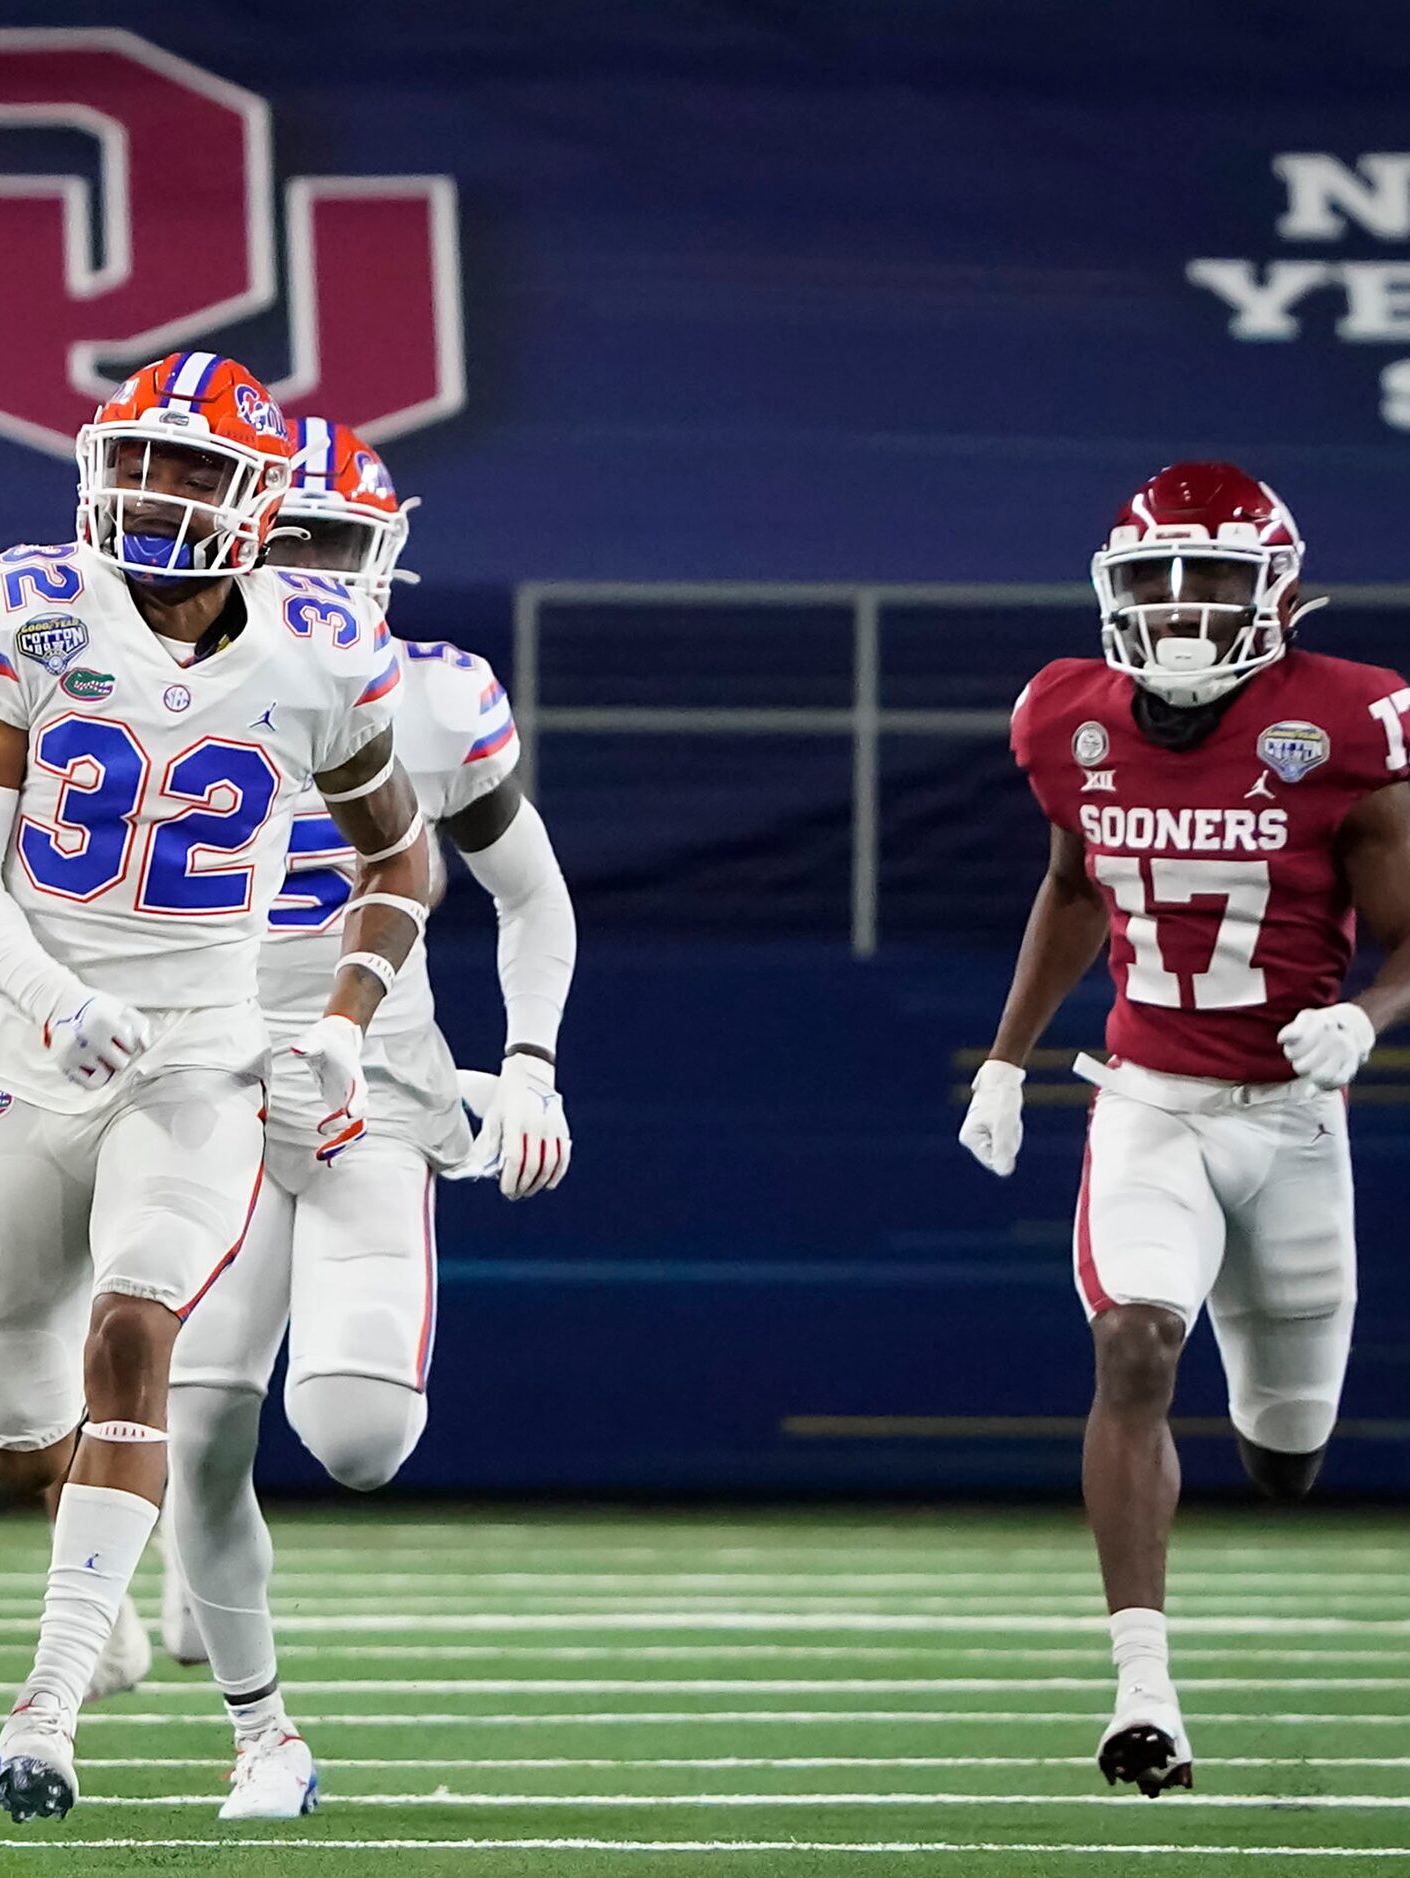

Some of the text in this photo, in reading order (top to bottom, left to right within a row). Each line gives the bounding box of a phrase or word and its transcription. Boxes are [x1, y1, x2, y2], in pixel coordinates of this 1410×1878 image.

[21, 626, 84, 653] COTTON
[16, 710, 282, 916] 32
[1079, 804, 1289, 851] SOONERS
[1095, 856, 1270, 1010] 17
